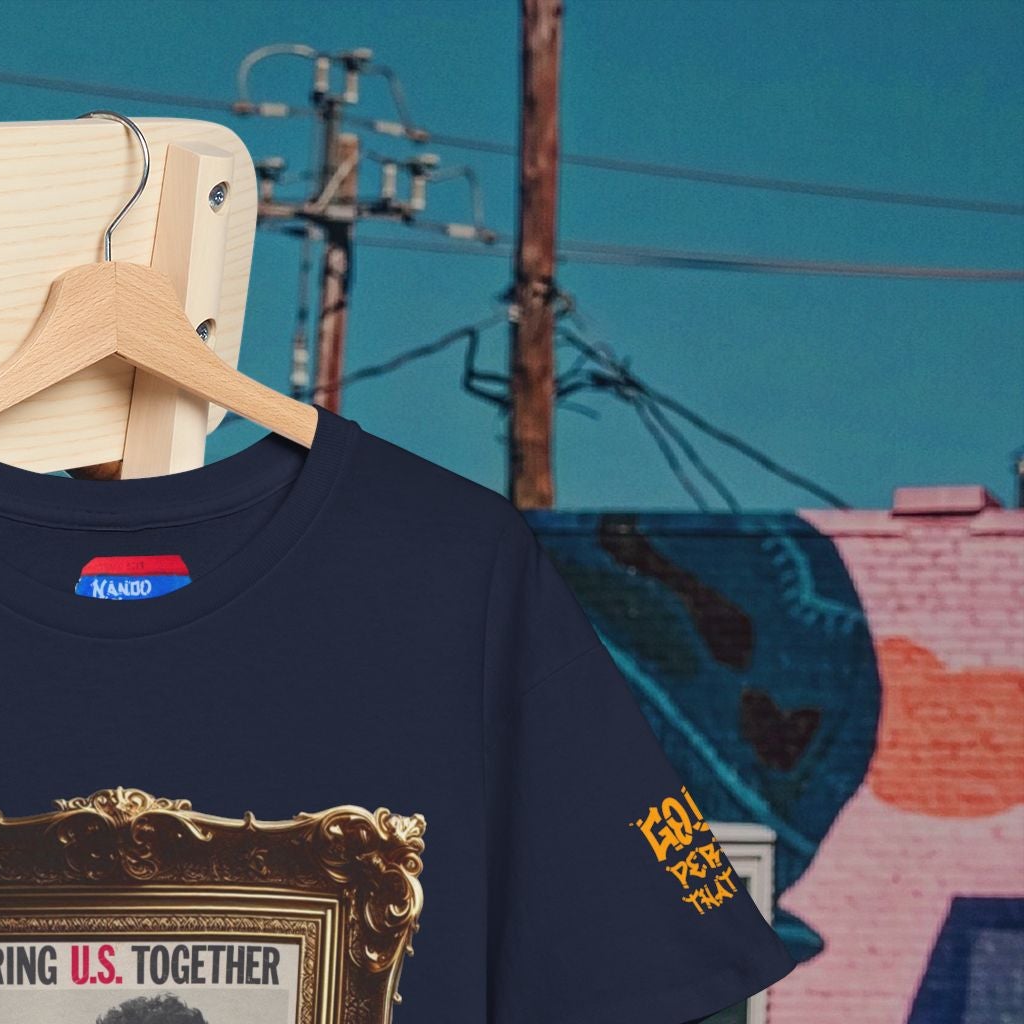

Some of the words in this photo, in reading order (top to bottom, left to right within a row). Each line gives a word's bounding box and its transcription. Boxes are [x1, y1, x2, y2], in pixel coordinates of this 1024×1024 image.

[91, 578, 152, 600] NANDO
[682, 866, 738, 915] THAT
[71, 945, 123, 984] U.S.
[131, 945, 280, 985] TOGETHER
